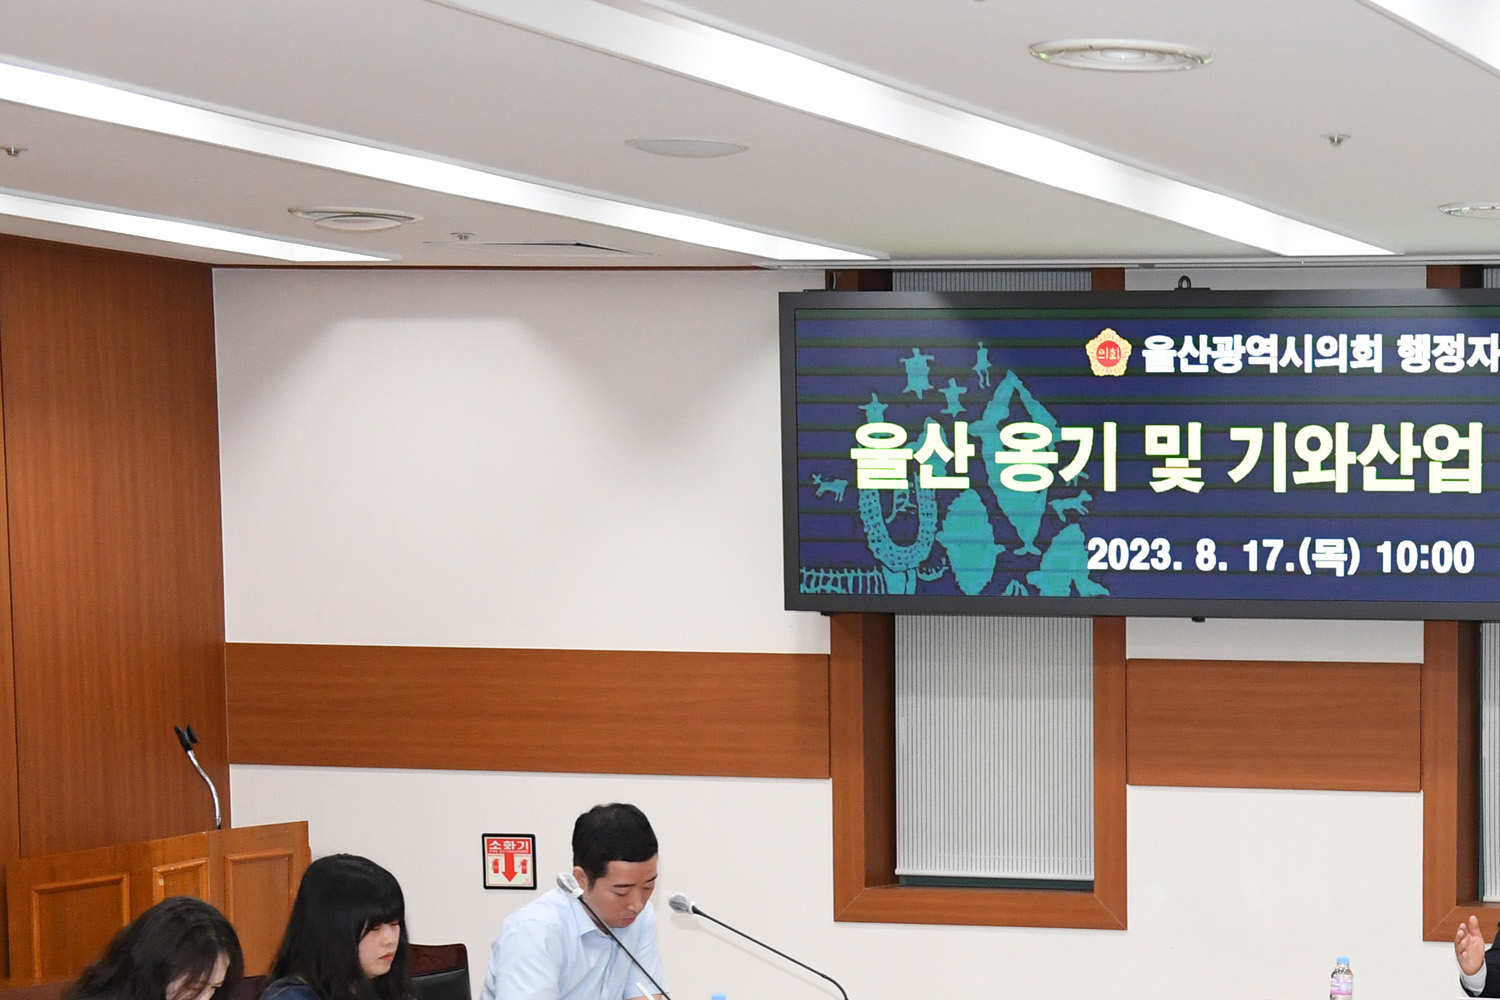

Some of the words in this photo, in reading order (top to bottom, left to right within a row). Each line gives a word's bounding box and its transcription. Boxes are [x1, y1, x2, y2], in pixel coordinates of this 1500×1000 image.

[1142, 333, 1382, 373] 울산광역시의회
[851, 422, 974, 489] 울산
[995, 422, 1116, 491] 옹기
[1146, 422, 1204, 493] 및
[1228, 422, 1482, 493] 기와산업
[1087, 538, 1182, 571] 2023.
[1196, 538, 1227, 571] 8.
[1243, 537, 1360, 576] 17.(목)
[1377, 541, 1474, 573] 10:00
[489, 840, 529, 850] 소화기
